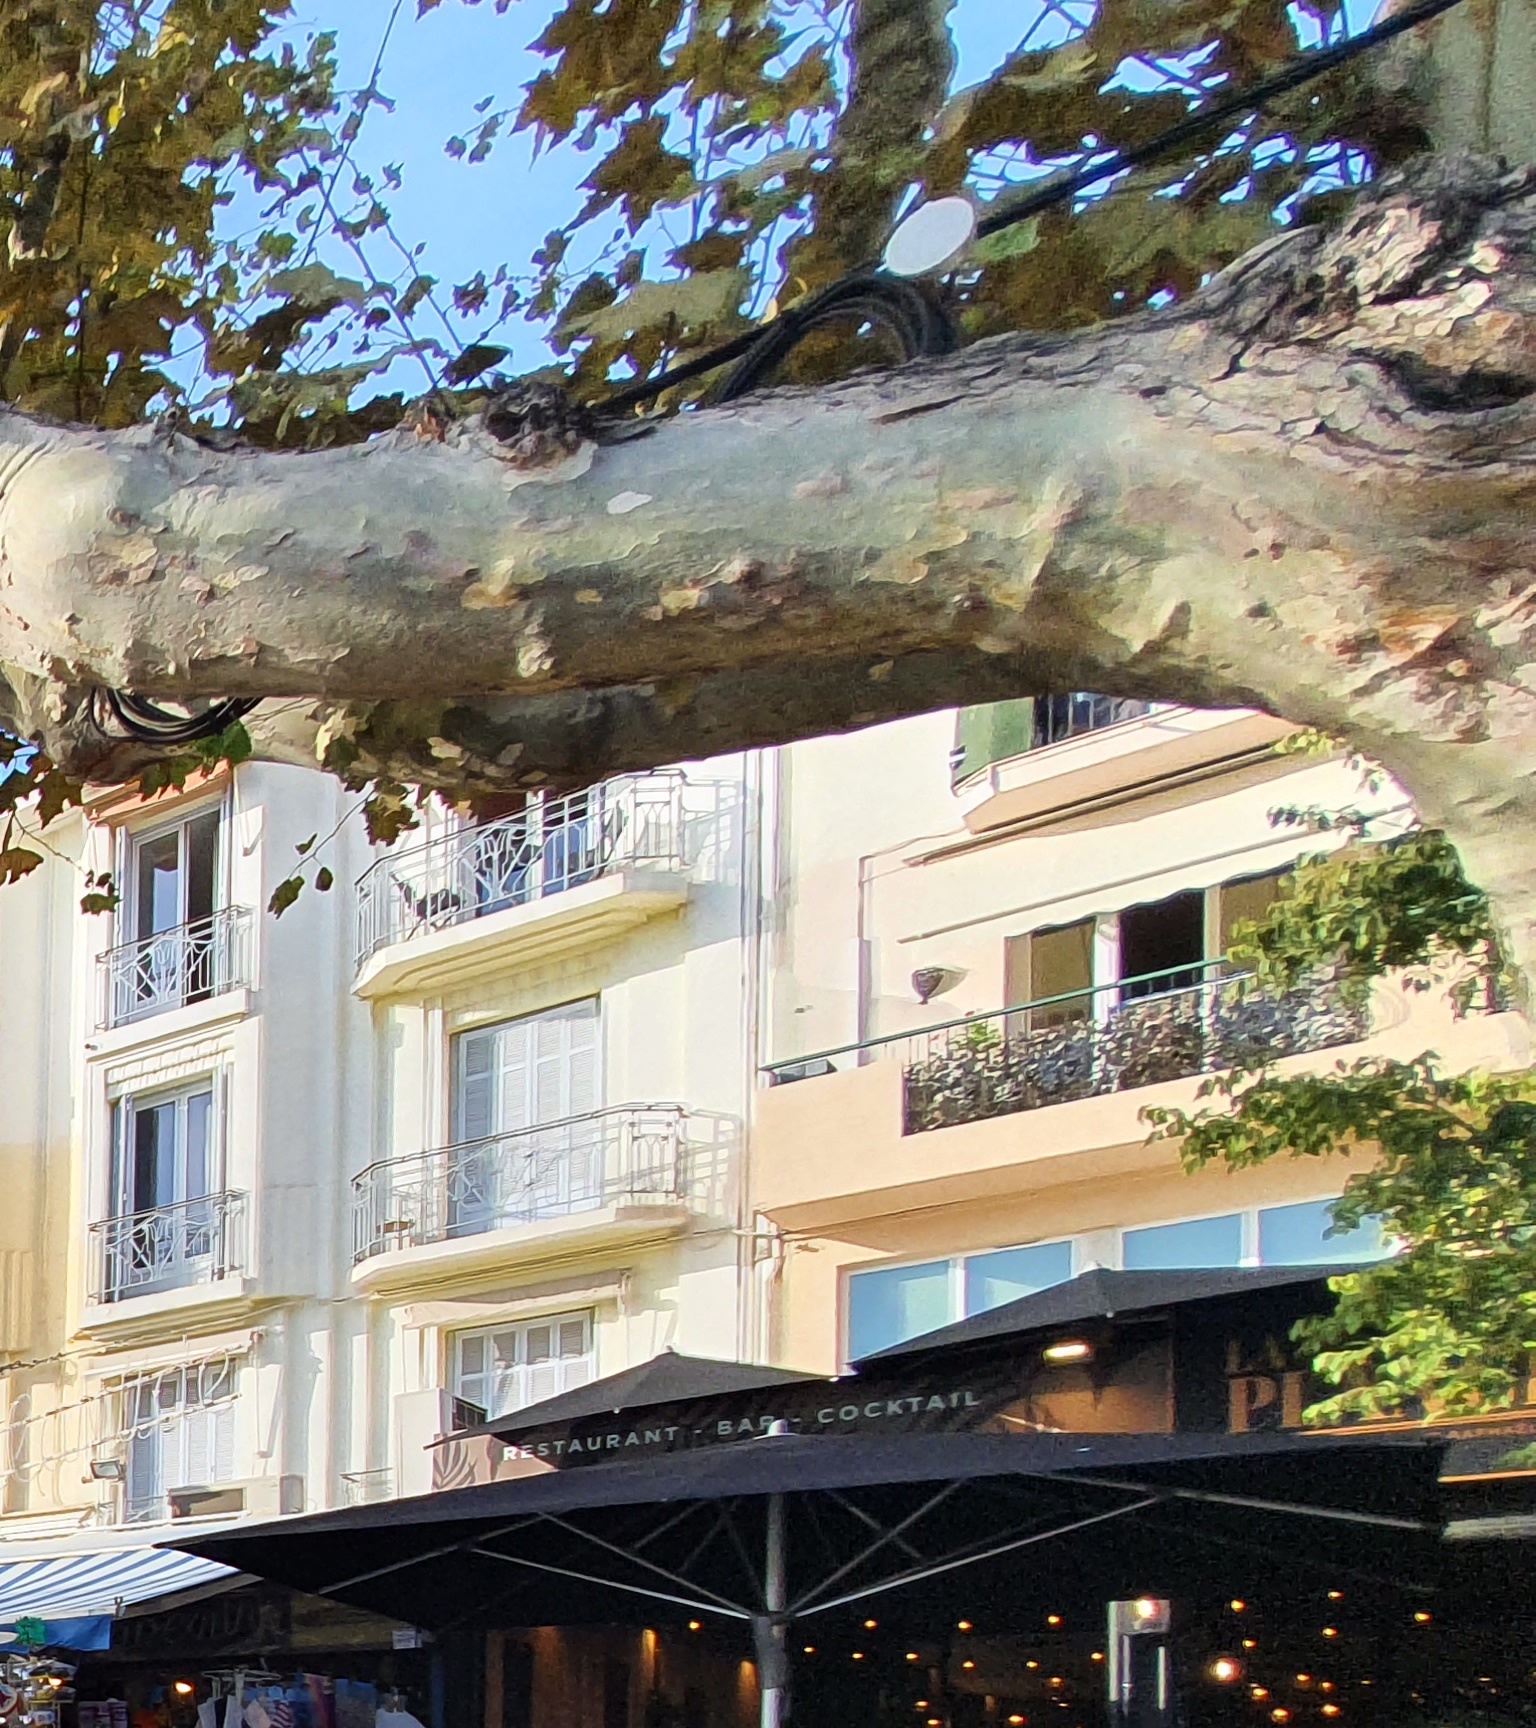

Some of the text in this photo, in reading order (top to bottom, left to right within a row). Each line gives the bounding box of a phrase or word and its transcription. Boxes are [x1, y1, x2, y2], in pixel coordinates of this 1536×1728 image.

[502, 1425, 679, 1462] RESTAURANT
[717, 1414, 777, 1437] BAR
[816, 1390, 980, 1424] COCKTAIL
